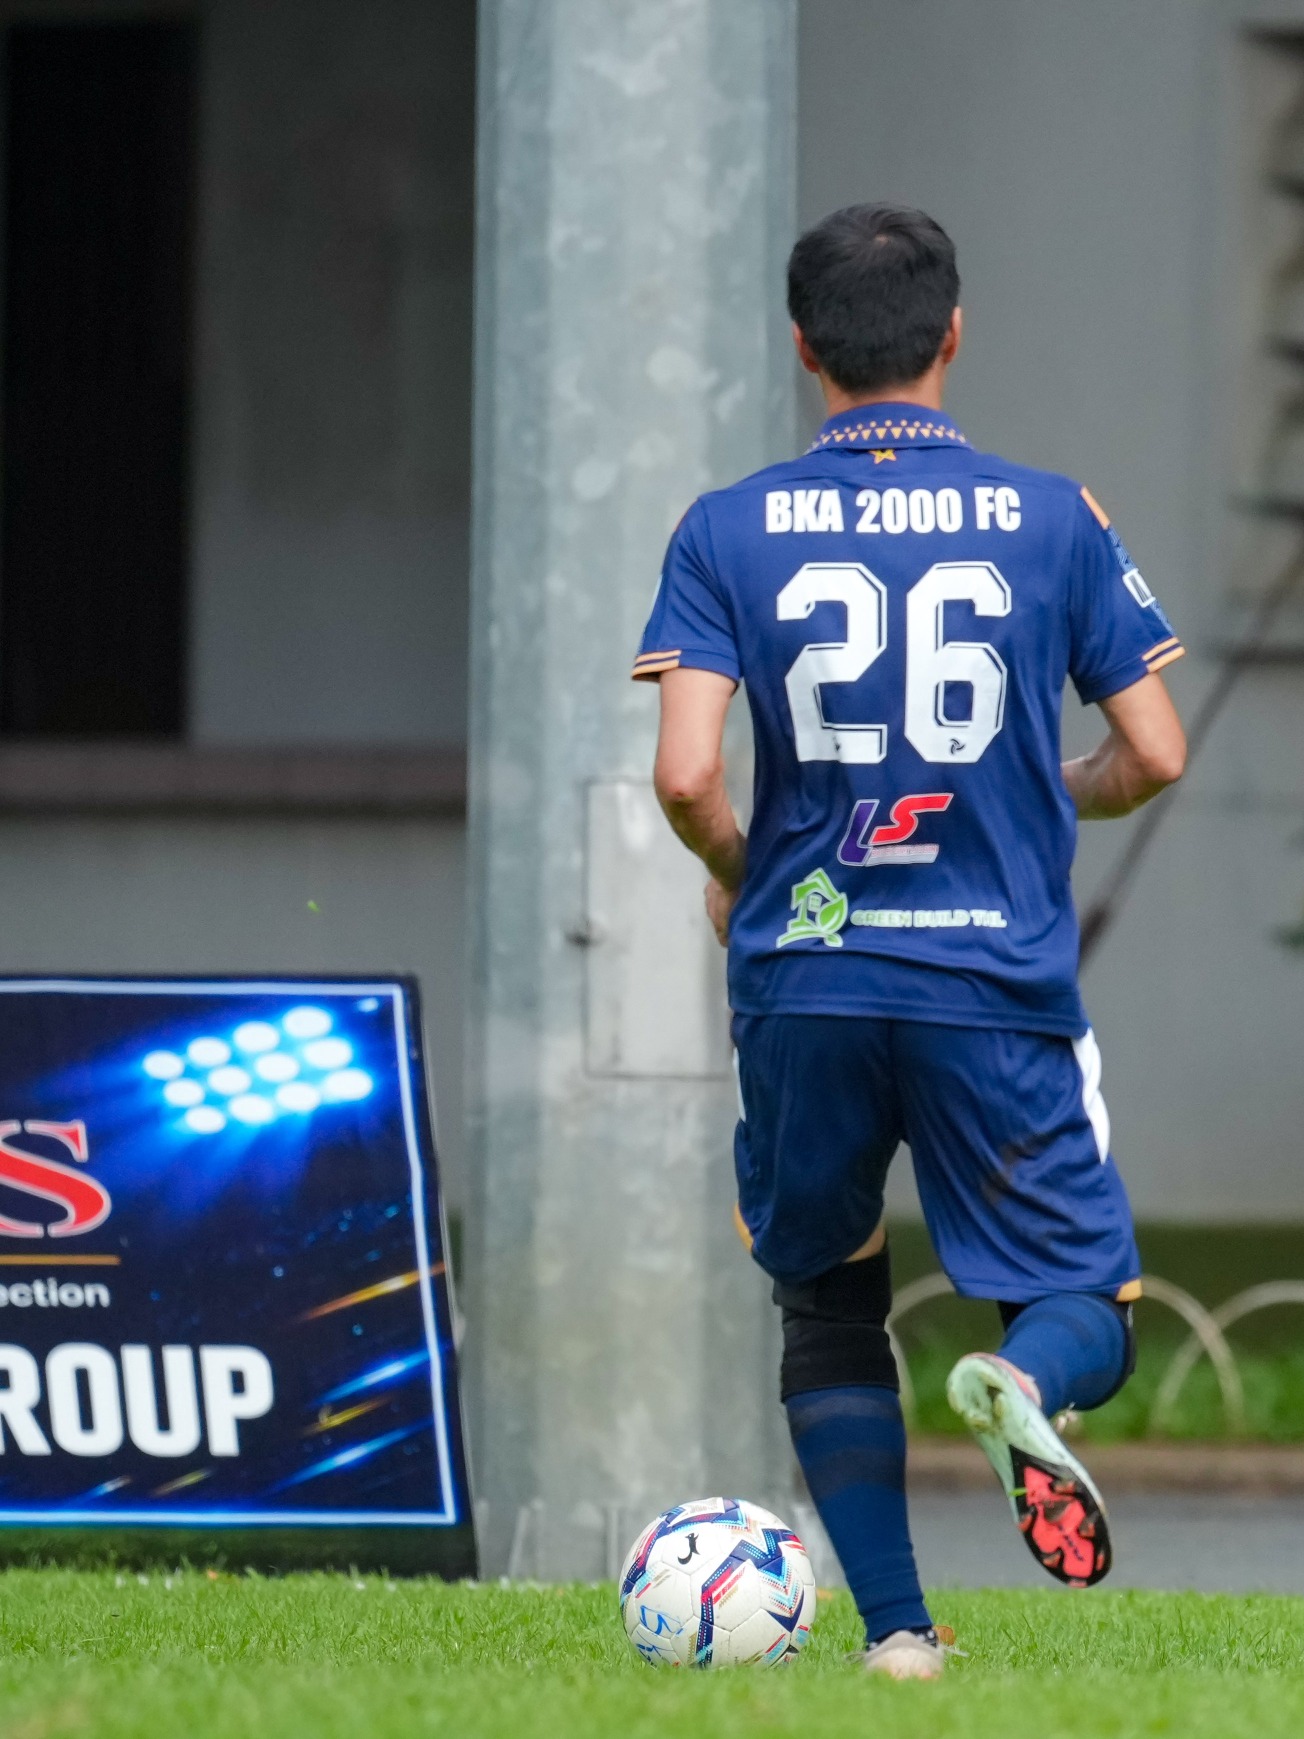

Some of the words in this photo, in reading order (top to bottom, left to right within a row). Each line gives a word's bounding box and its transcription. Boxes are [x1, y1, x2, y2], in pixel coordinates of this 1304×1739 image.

[765, 489, 844, 534] BKA
[855, 487, 964, 534] 2000
[973, 486, 1022, 532] FC
[776, 560, 1012, 764] 26
[850, 909, 913, 928] GREEN
[913, 909, 970, 928] BUILD
